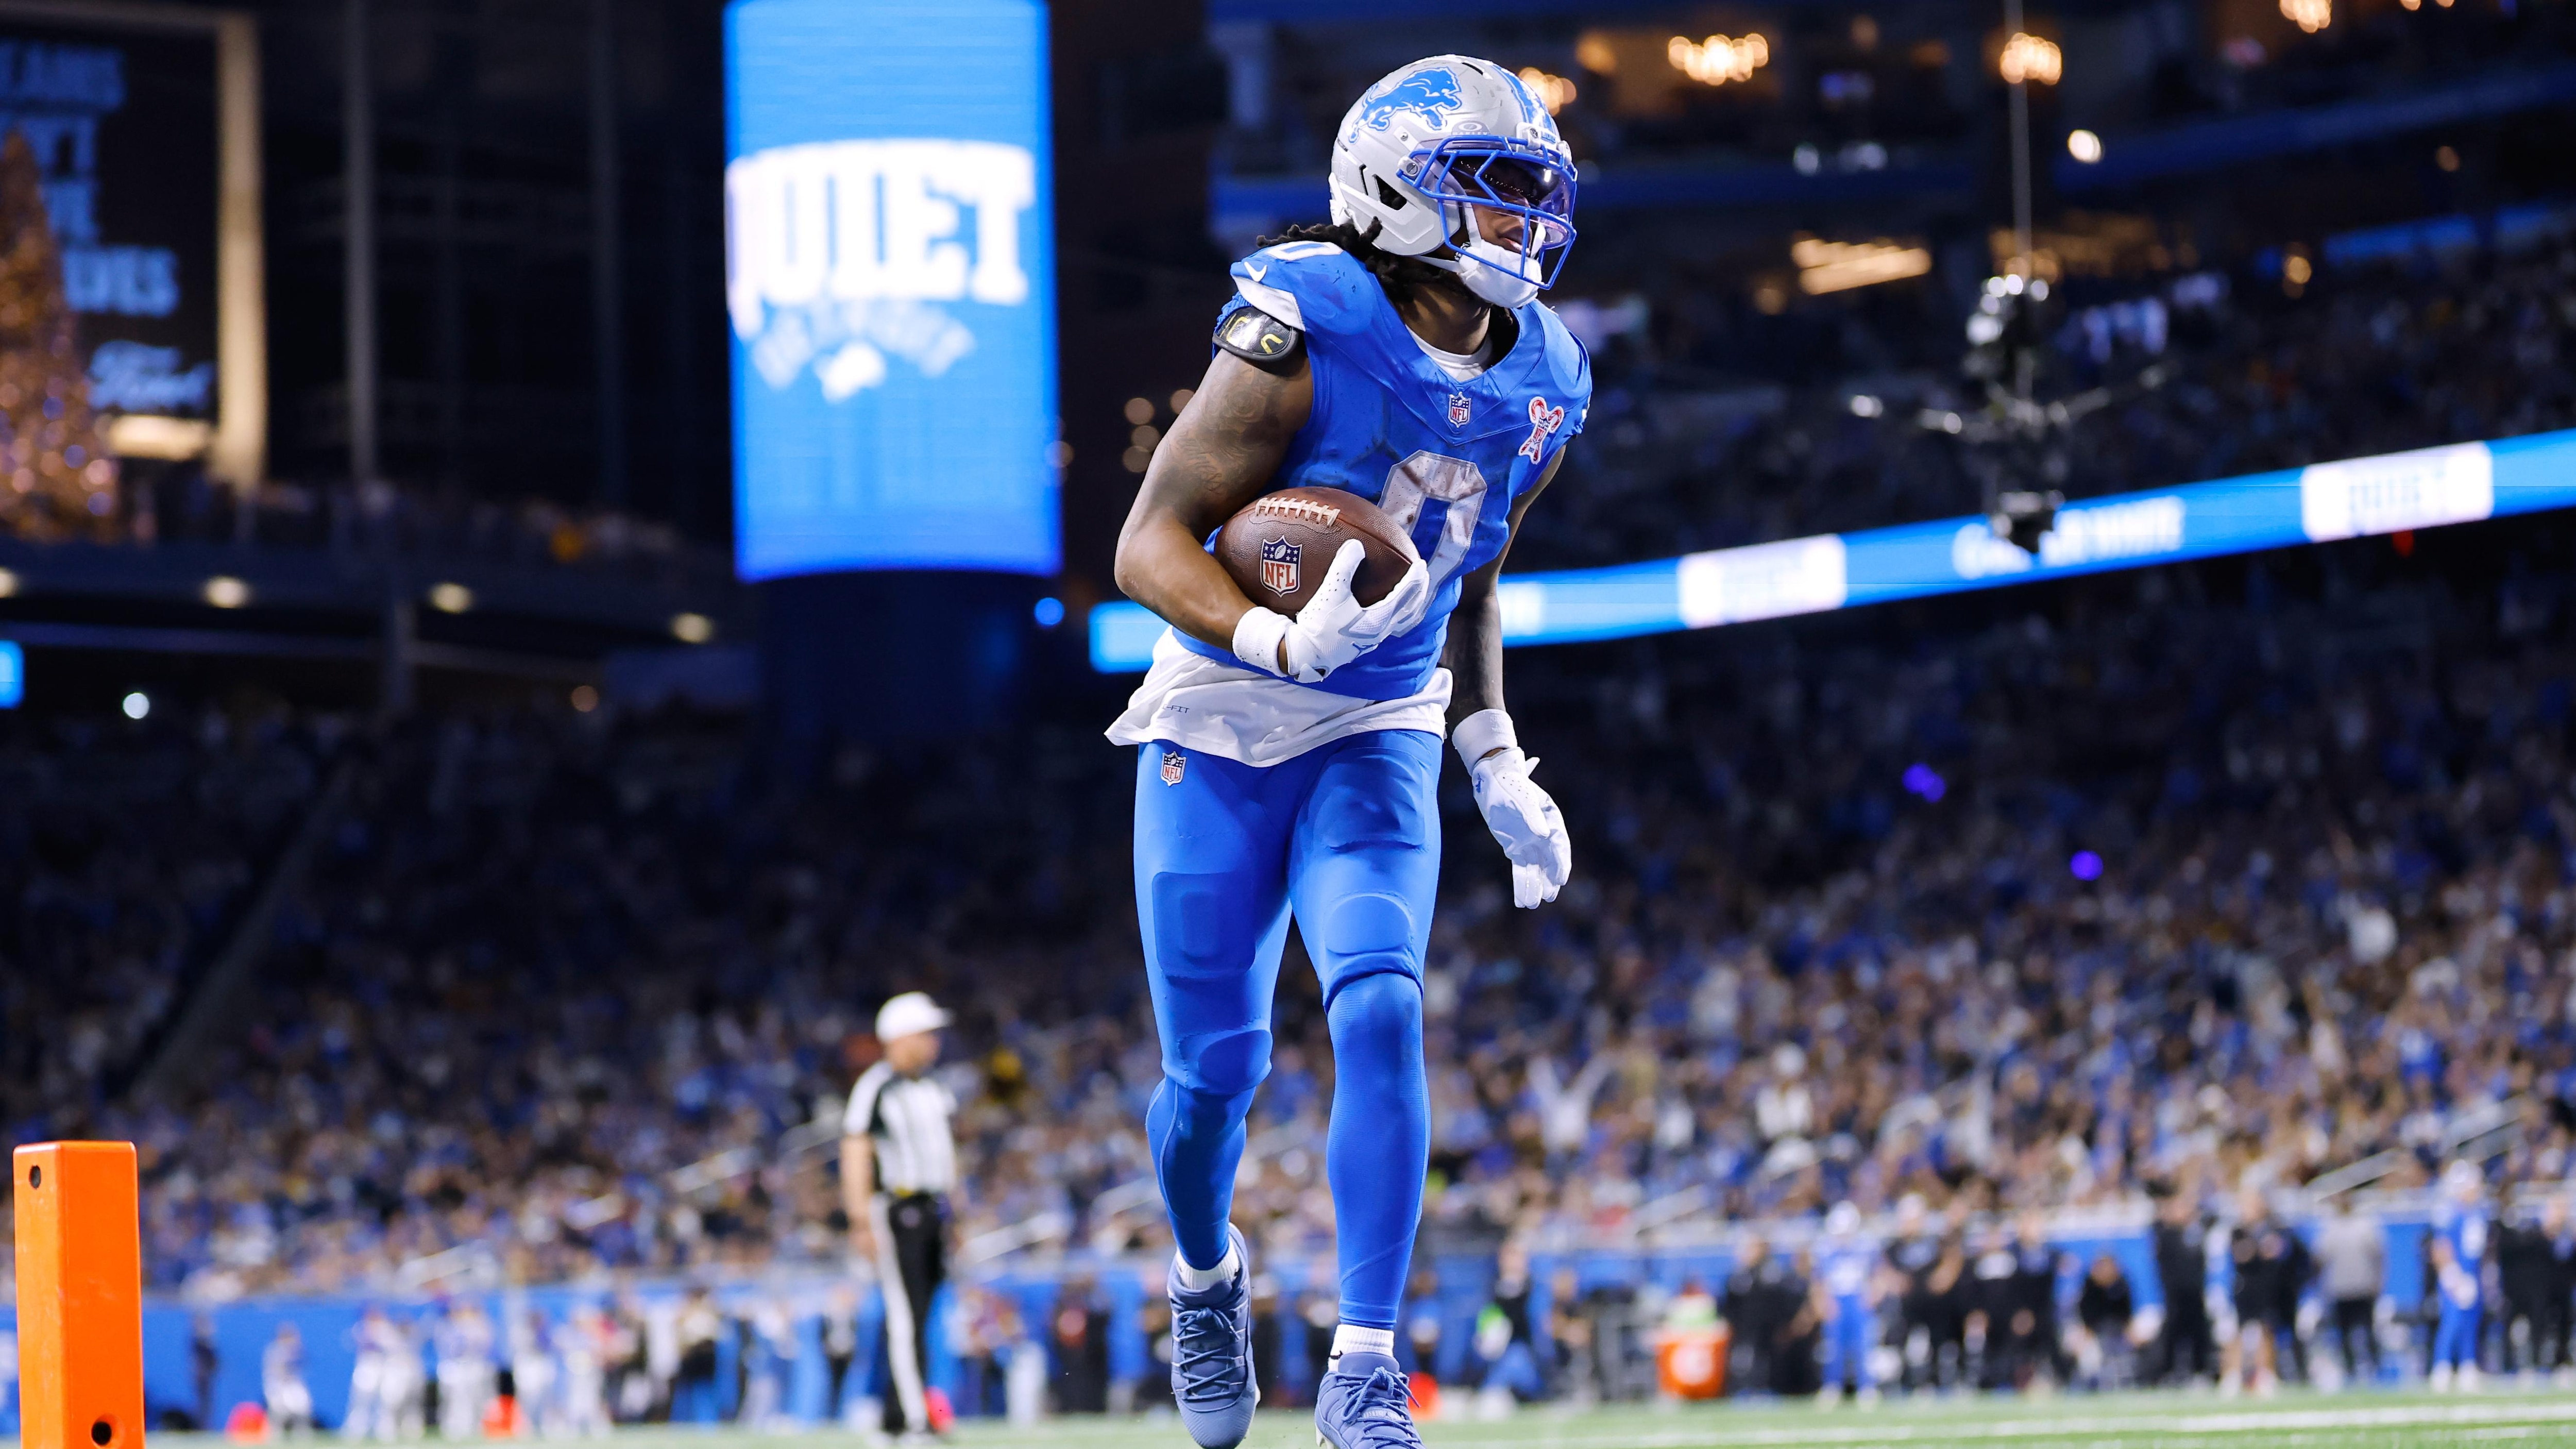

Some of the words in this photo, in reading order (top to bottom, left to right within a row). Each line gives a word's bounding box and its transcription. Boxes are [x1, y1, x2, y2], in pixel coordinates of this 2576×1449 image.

[724, 138, 1035, 341] QUIET
[1452, 408, 1466, 420] NFL
[1264, 562, 1295, 589] NFL
[1164, 766, 1179, 779] NFL
